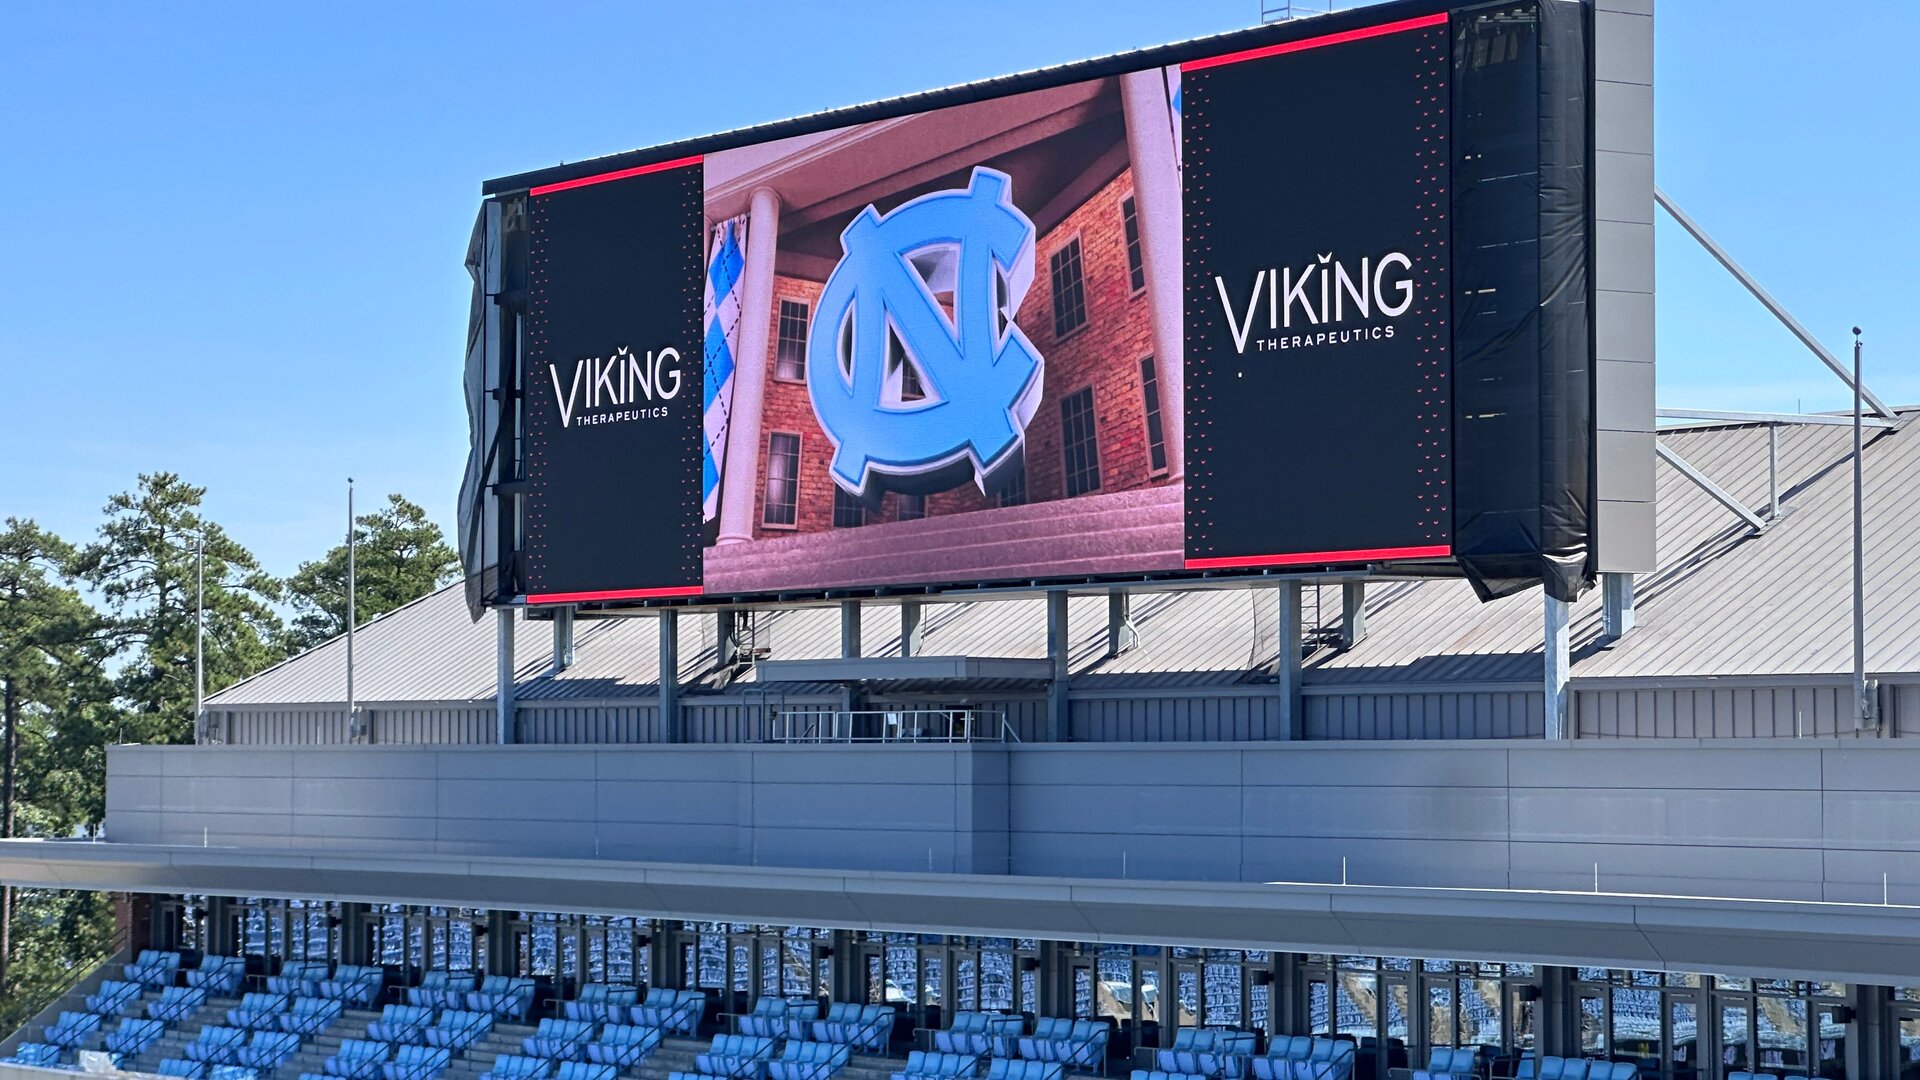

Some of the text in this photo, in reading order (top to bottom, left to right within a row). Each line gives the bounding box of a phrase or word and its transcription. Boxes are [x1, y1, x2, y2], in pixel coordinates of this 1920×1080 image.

[1214, 252, 1413, 354] VIKING
[1256, 325, 1395, 352] THERAPEUTICS
[549, 346, 681, 428] VIKING
[576, 406, 668, 426] THERAPEUTICS
